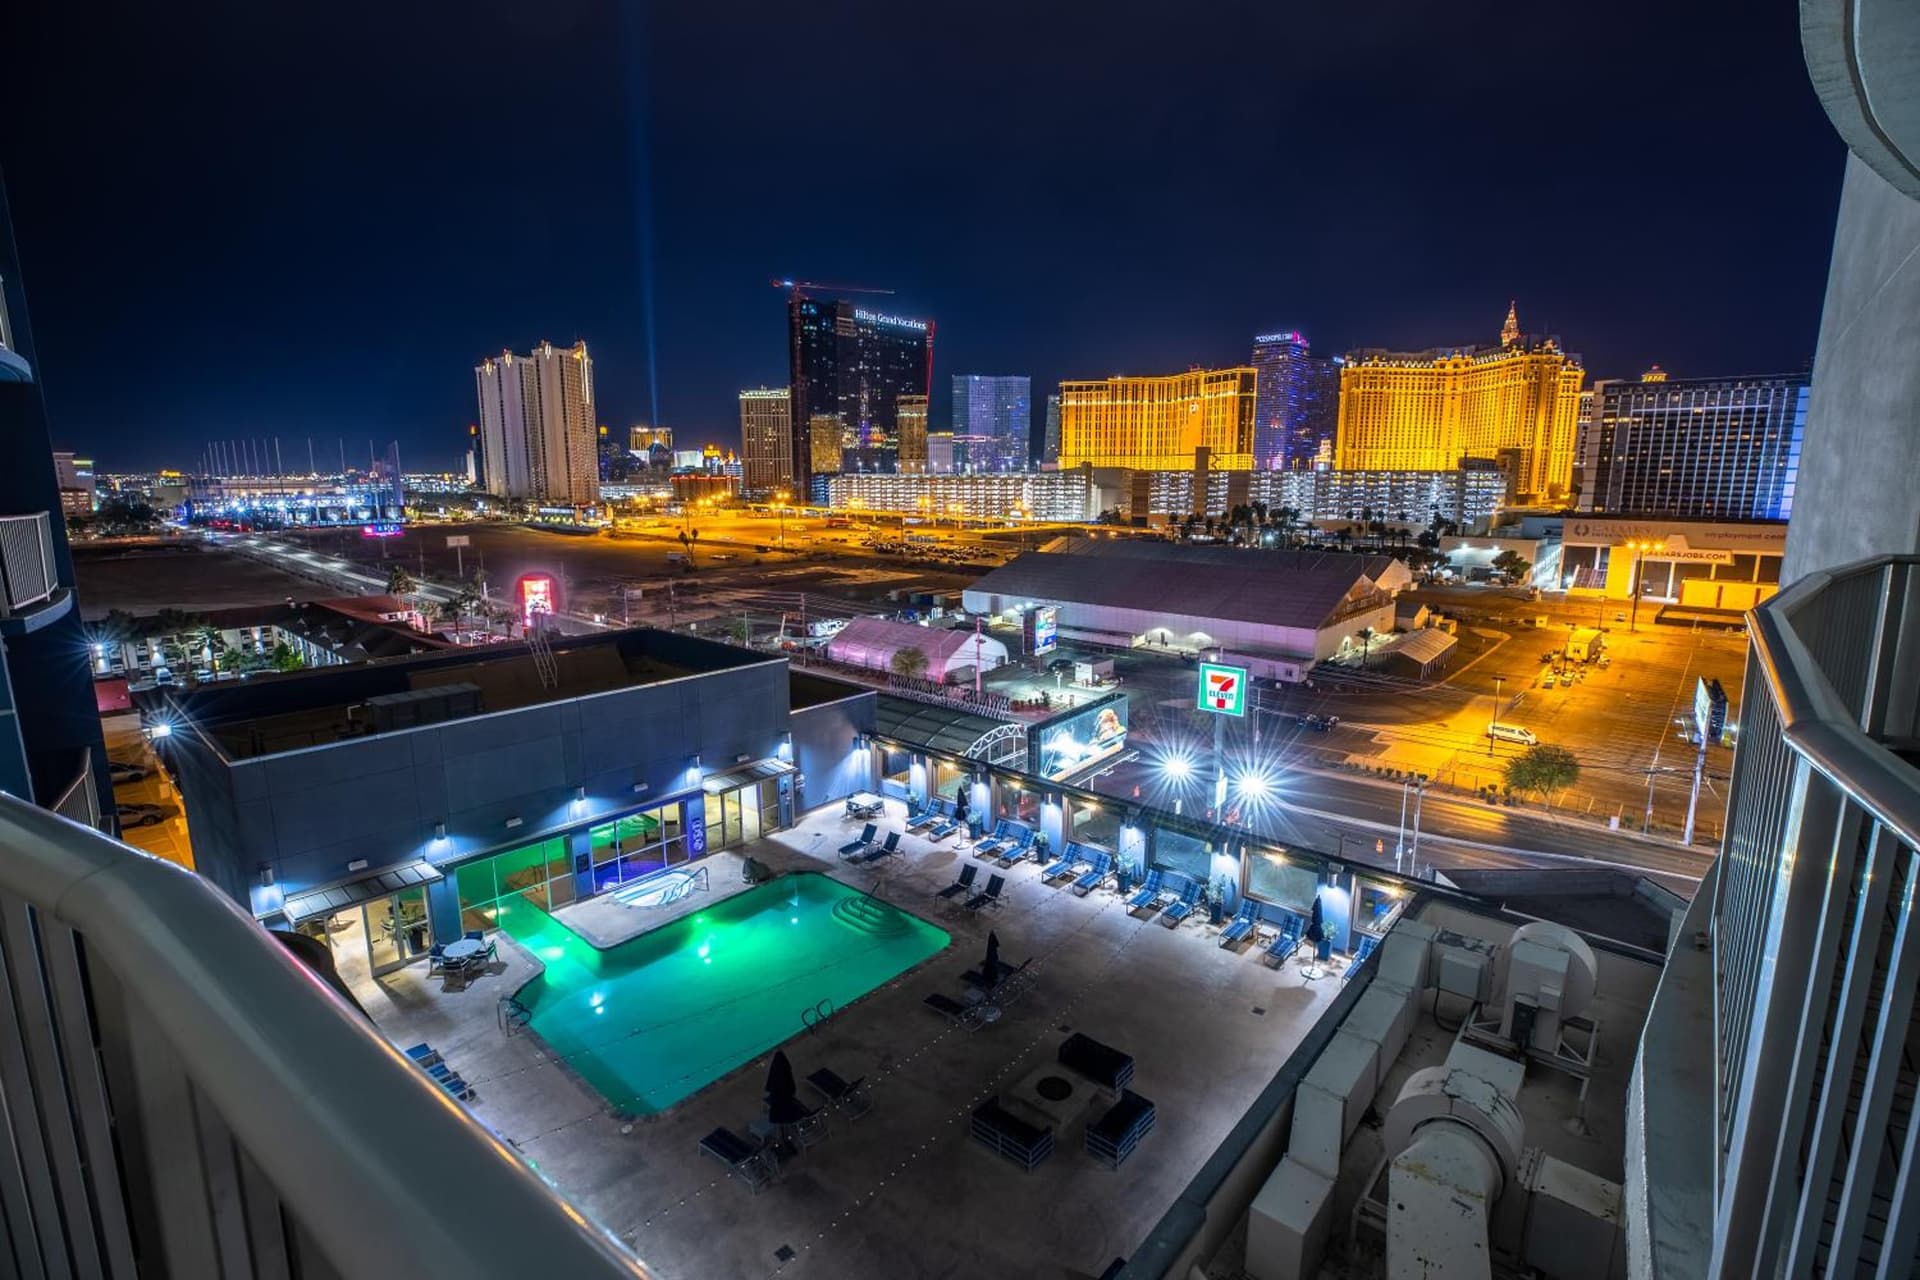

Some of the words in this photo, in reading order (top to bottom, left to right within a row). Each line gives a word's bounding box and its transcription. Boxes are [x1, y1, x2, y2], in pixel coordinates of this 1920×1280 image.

[855, 309, 876, 320] Hilton
[877, 313, 897, 325] Grand
[897, 316, 927, 330] Vacations
[1210, 674, 1234, 709] 7
